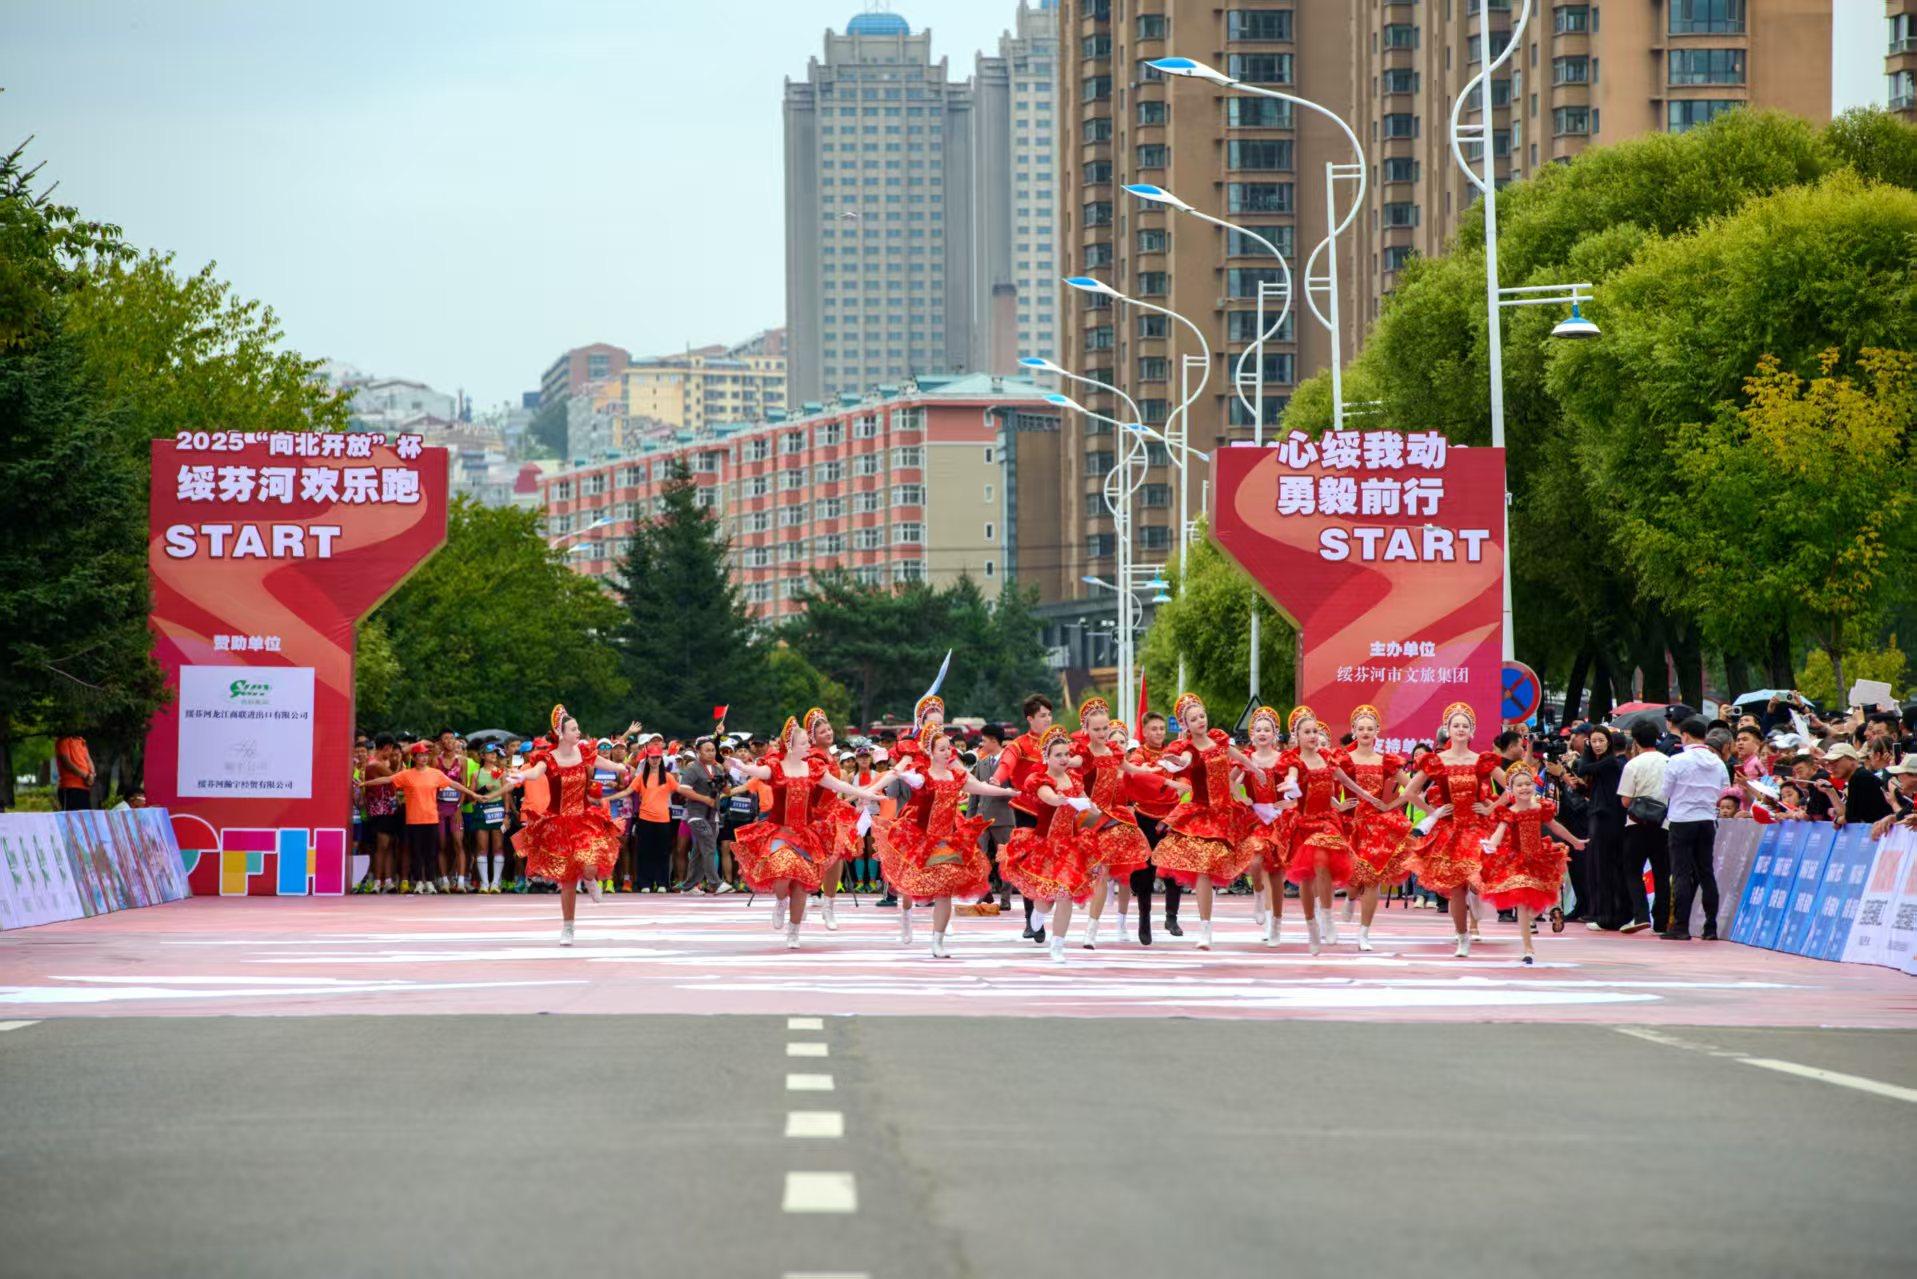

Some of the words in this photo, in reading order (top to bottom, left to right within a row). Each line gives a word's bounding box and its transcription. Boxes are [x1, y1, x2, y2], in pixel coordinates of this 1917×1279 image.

[1278, 430, 1447, 470] 心绥我动
[176, 465, 421, 503] 绥芬河欢乐跑
[1277, 476, 1445, 516] 勇毅前行
[165, 524, 341, 558] START
[1319, 527, 1490, 562] START
[1369, 641, 1436, 658] 主办单位
[1336, 665, 1469, 683] 绥芬河市文旅集团
